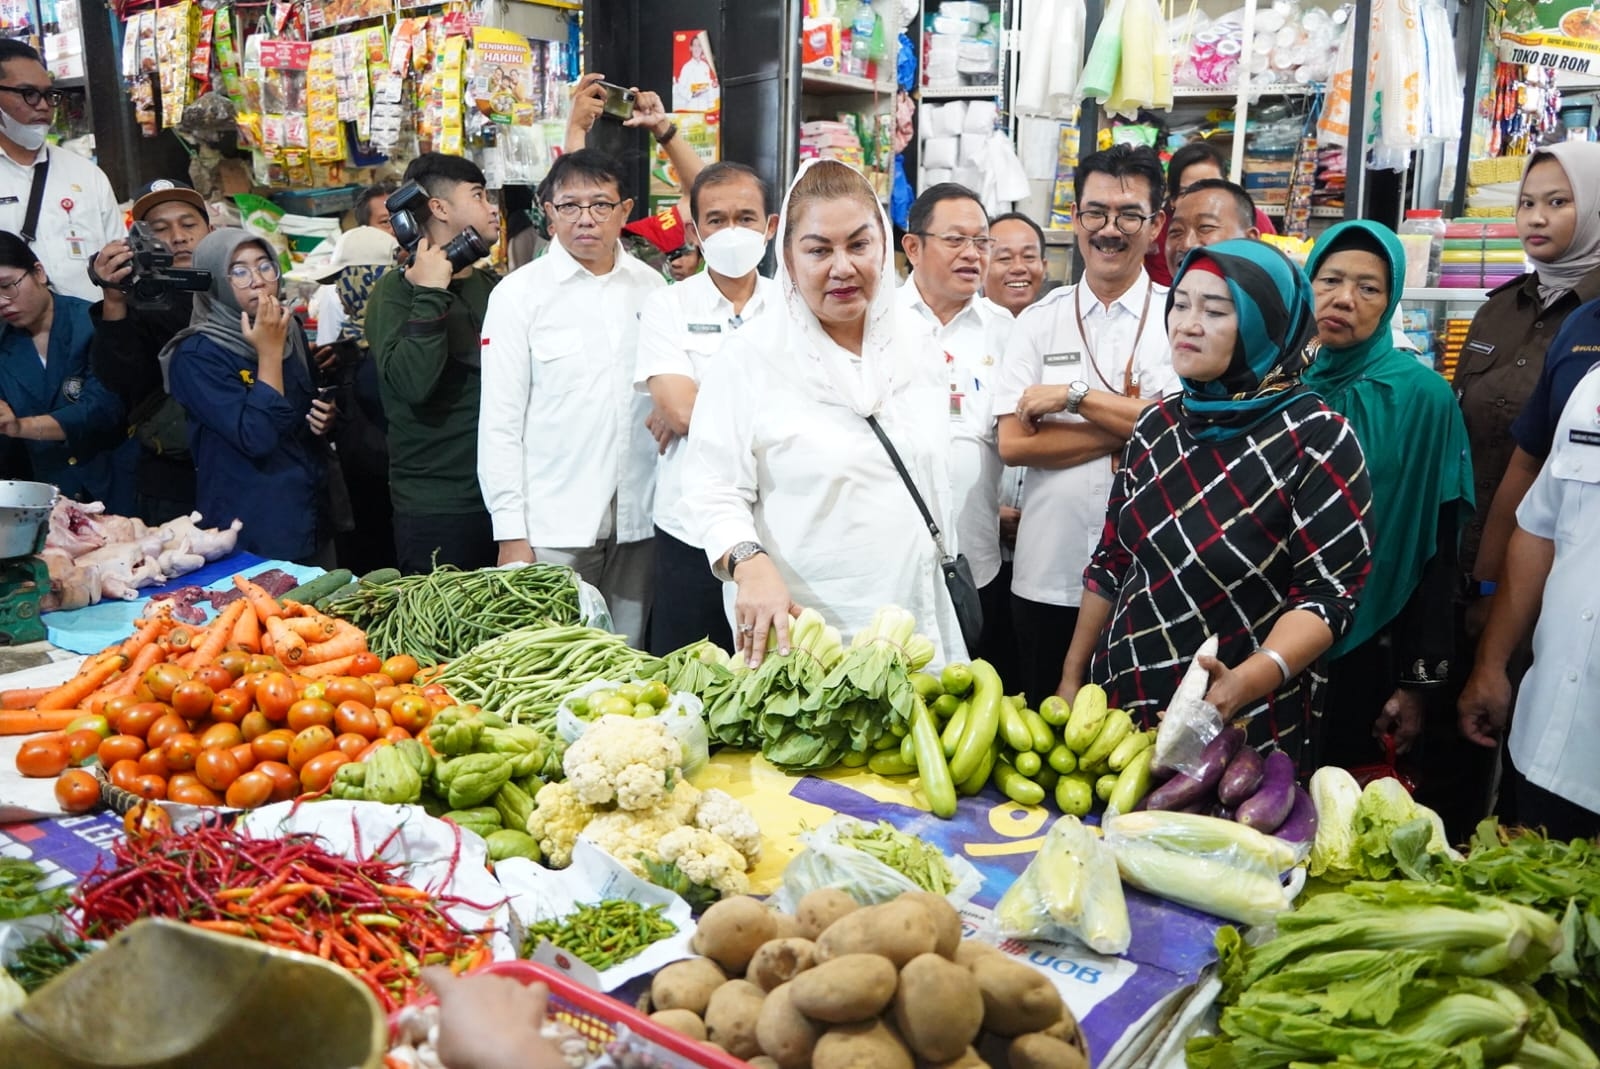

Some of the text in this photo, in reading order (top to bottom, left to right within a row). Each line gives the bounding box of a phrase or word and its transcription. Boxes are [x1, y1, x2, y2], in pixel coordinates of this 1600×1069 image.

[484, 52, 523, 64] HAKIKI
[1512, 48, 1591, 73] TOKO BU ROM
[1029, 950, 1103, 985] UOB
